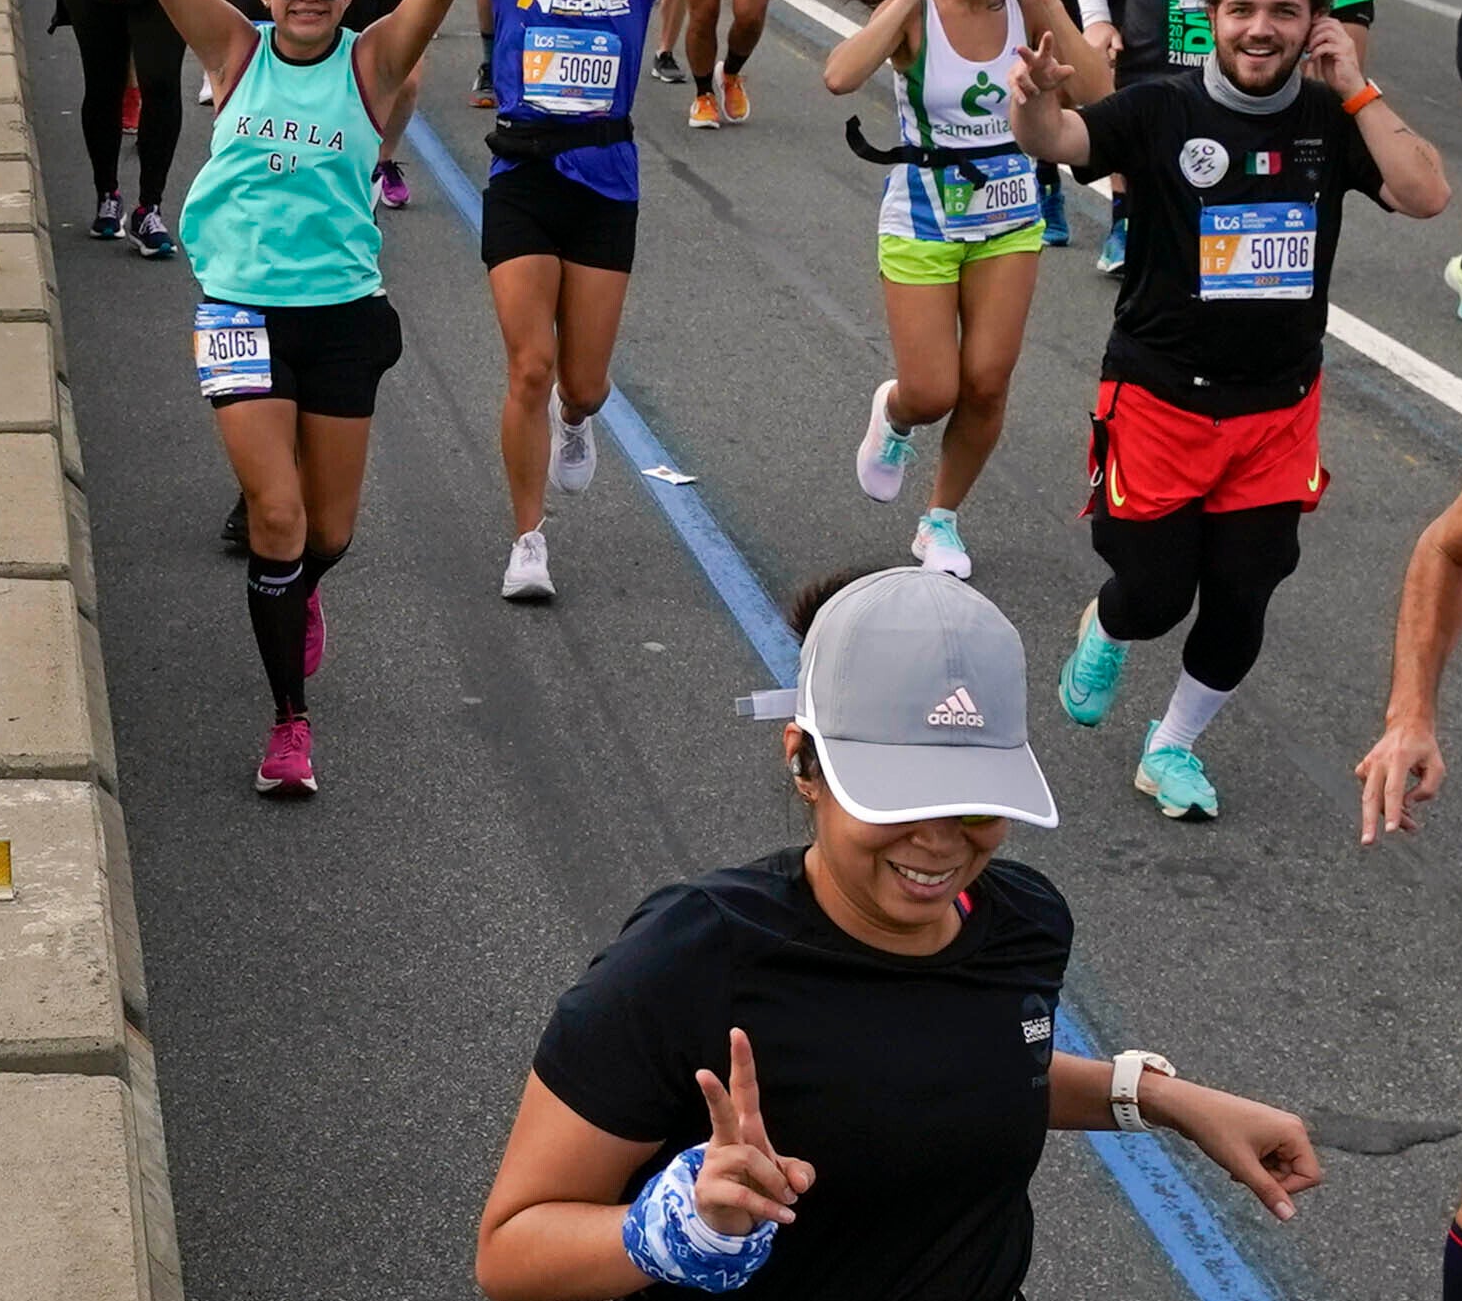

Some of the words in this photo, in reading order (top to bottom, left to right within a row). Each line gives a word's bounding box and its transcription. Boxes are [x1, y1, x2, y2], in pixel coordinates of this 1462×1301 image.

[534, 34, 554, 48] tcs
[559, 56, 612, 85] 50609
[235, 115, 344, 151] KARLA
[269, 152, 297, 173] G!
[986, 177, 1028, 210] 21686
[1214, 213, 1240, 231] tcs
[1251, 235, 1309, 270] 50786
[209, 330, 258, 361] 46165
[927, 711, 985, 729] adidas
